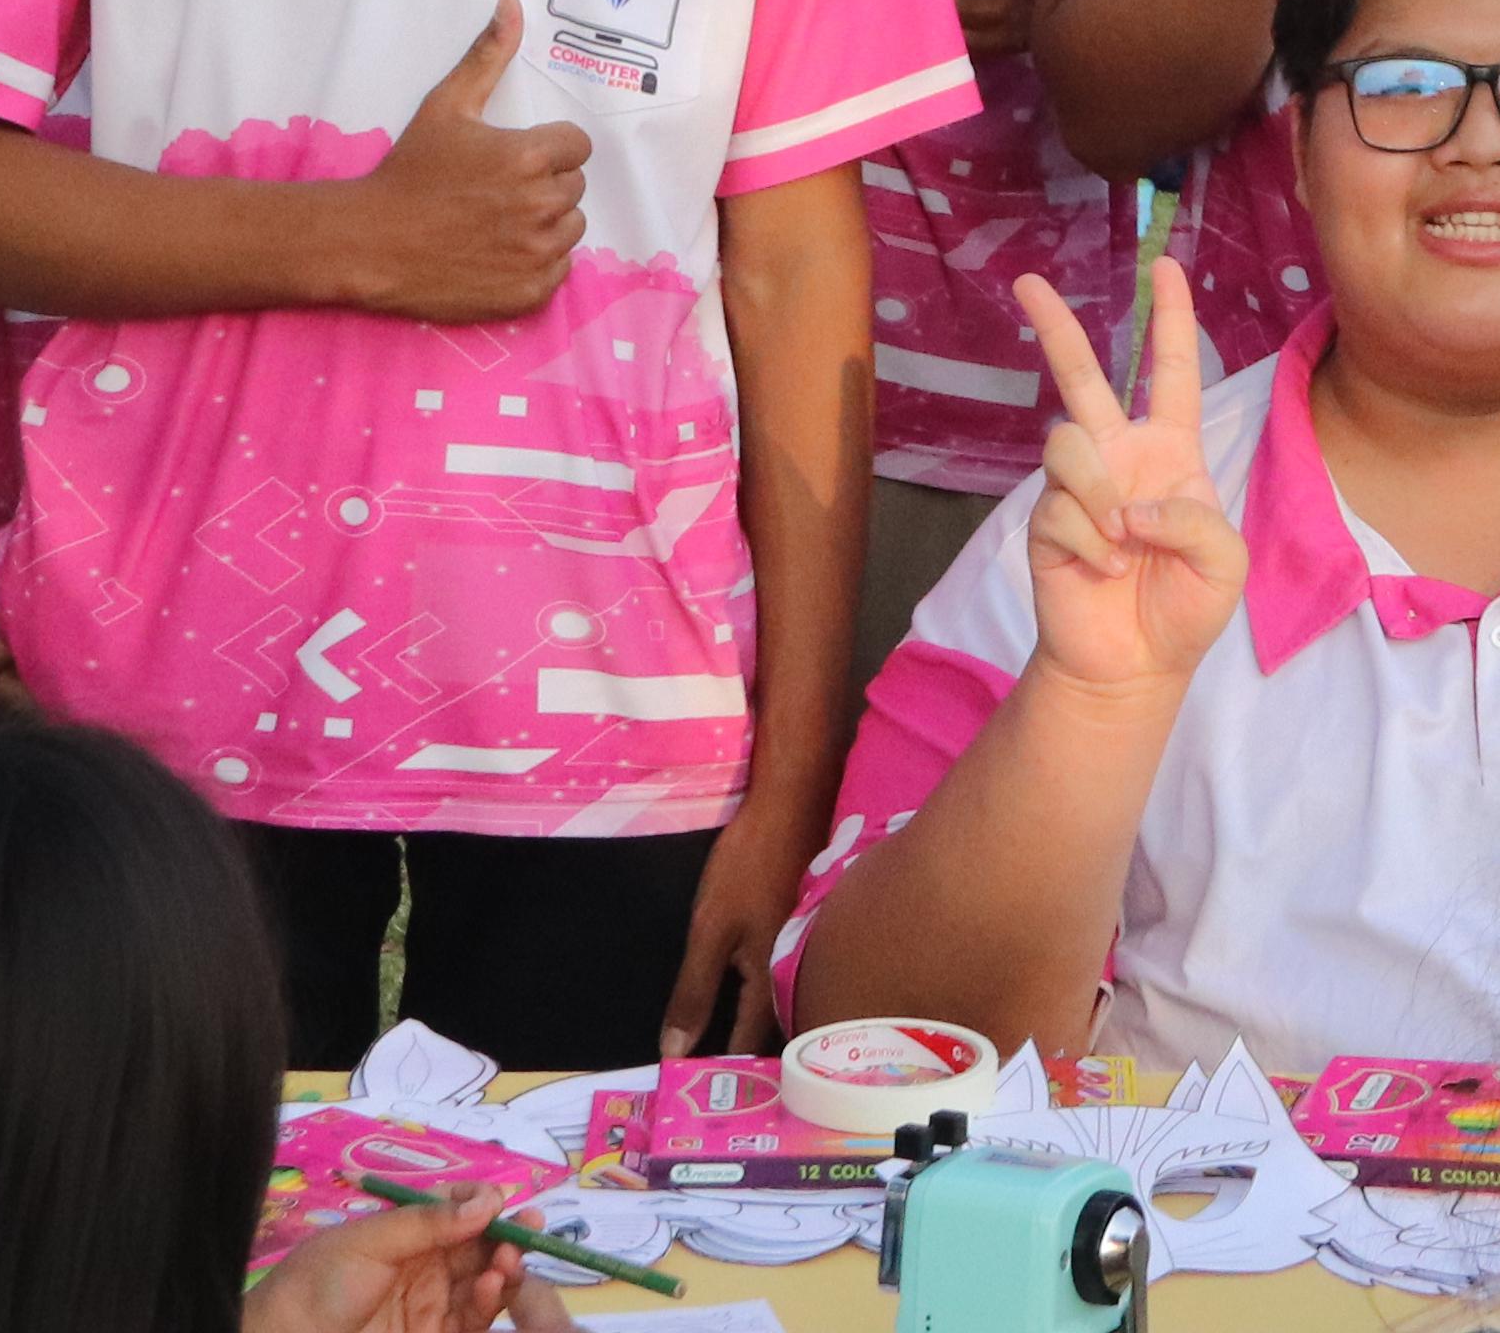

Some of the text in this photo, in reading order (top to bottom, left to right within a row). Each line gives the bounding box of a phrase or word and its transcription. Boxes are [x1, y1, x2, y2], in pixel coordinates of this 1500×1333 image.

[549, 45, 641, 82] COMPUTER
[607, 78, 640, 92] KPRU
[799, 1164, 821, 1180] 12
[1411, 1167, 1432, 1183] 12
